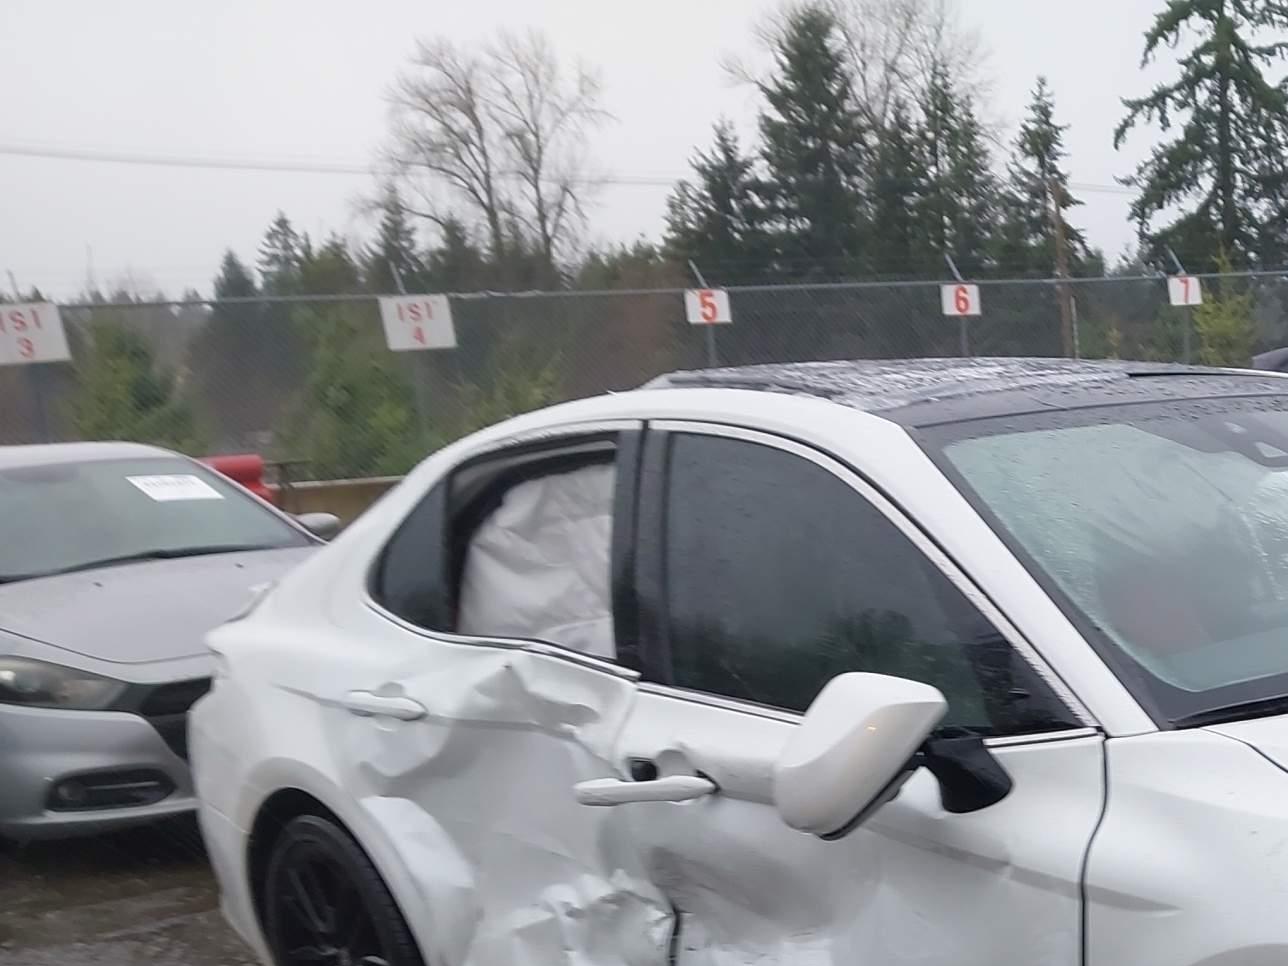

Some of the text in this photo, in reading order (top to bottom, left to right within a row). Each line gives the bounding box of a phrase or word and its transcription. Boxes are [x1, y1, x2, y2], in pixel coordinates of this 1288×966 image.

[954, 286, 971, 313] 6
[1179, 278, 1191, 304] 7
[697, 292, 718, 321] 5
